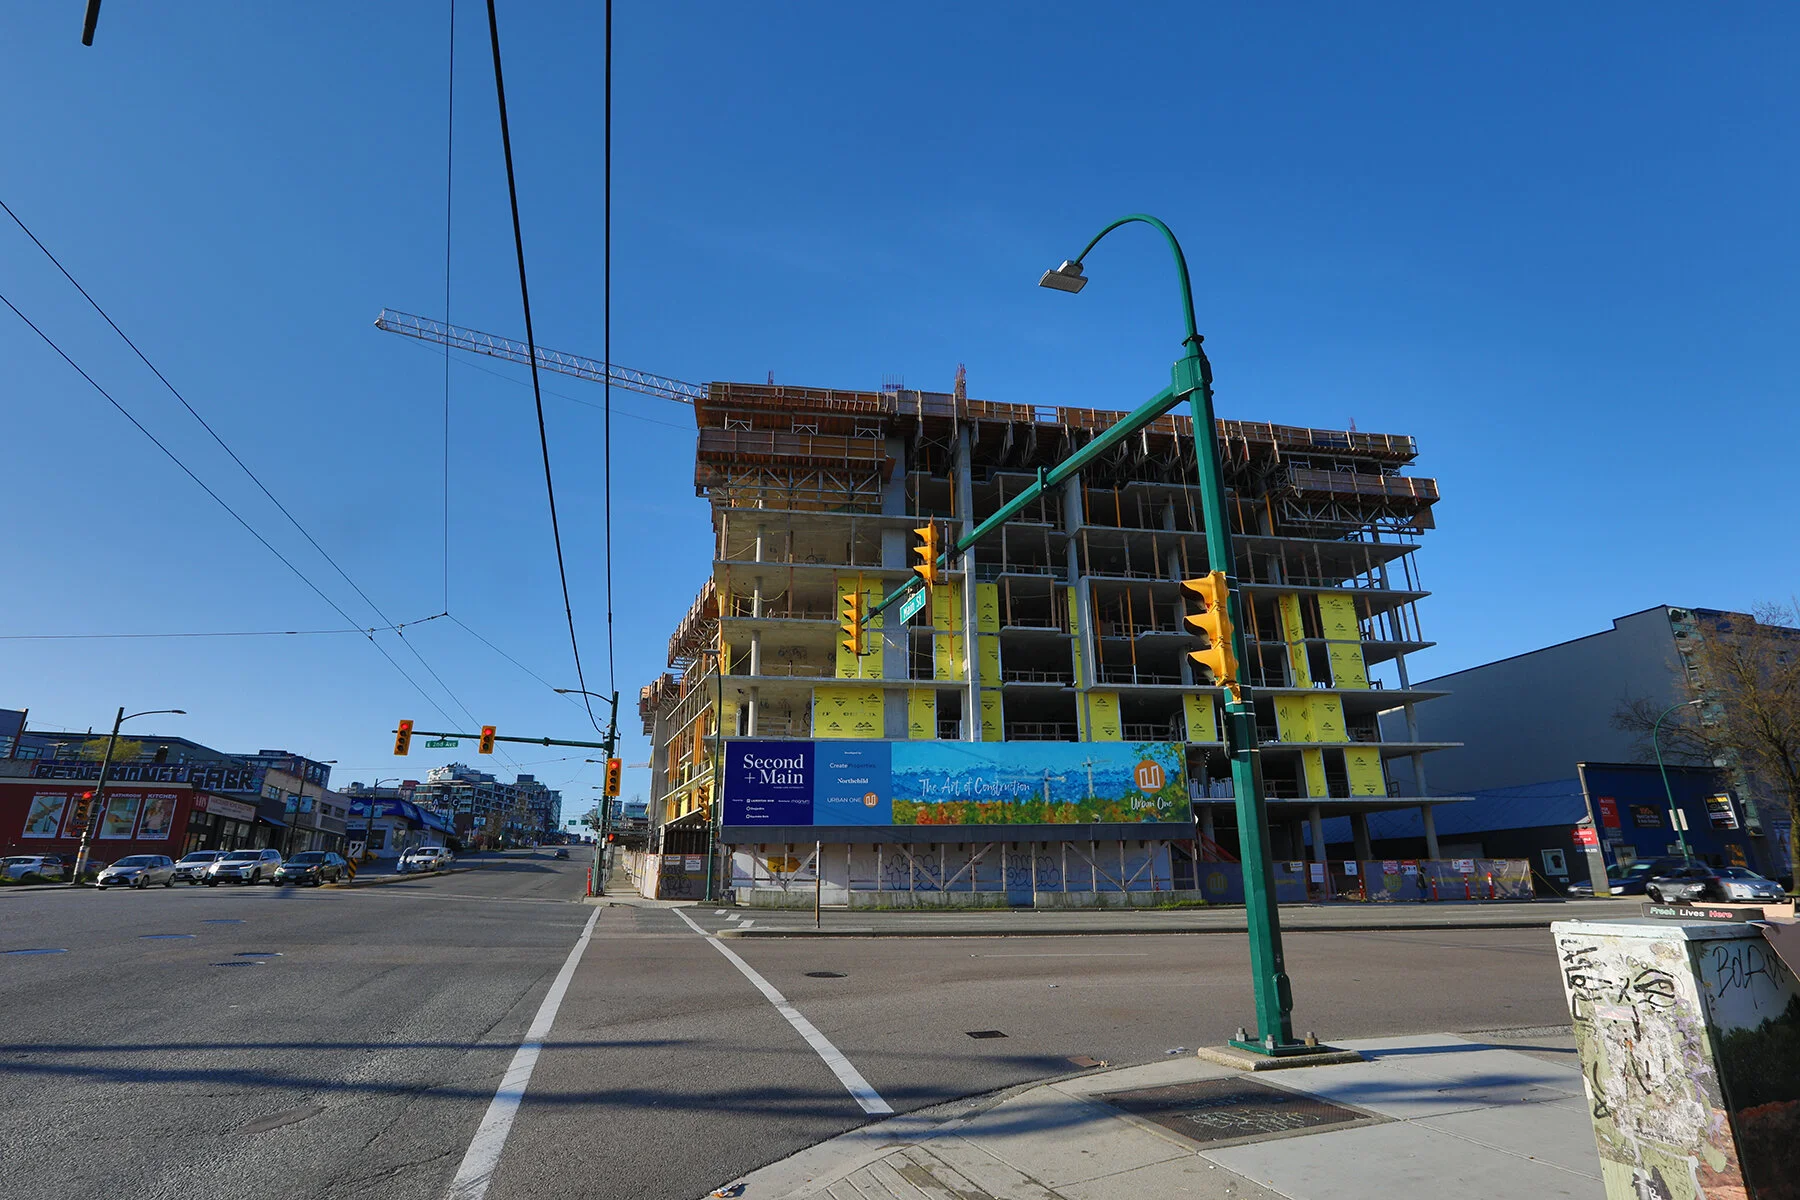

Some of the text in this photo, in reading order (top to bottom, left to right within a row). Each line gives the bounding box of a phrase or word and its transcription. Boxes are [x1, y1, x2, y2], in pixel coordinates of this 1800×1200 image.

[903, 594, 922, 619] Main St
[743, 753, 804, 769] Second
[759, 769, 804, 784] Main
[918, 776, 1030, 796] The Art of Construction
[1131, 796, 1172, 810] Urban One
[1650, 907, 1733, 919] Fresh Lives Here
